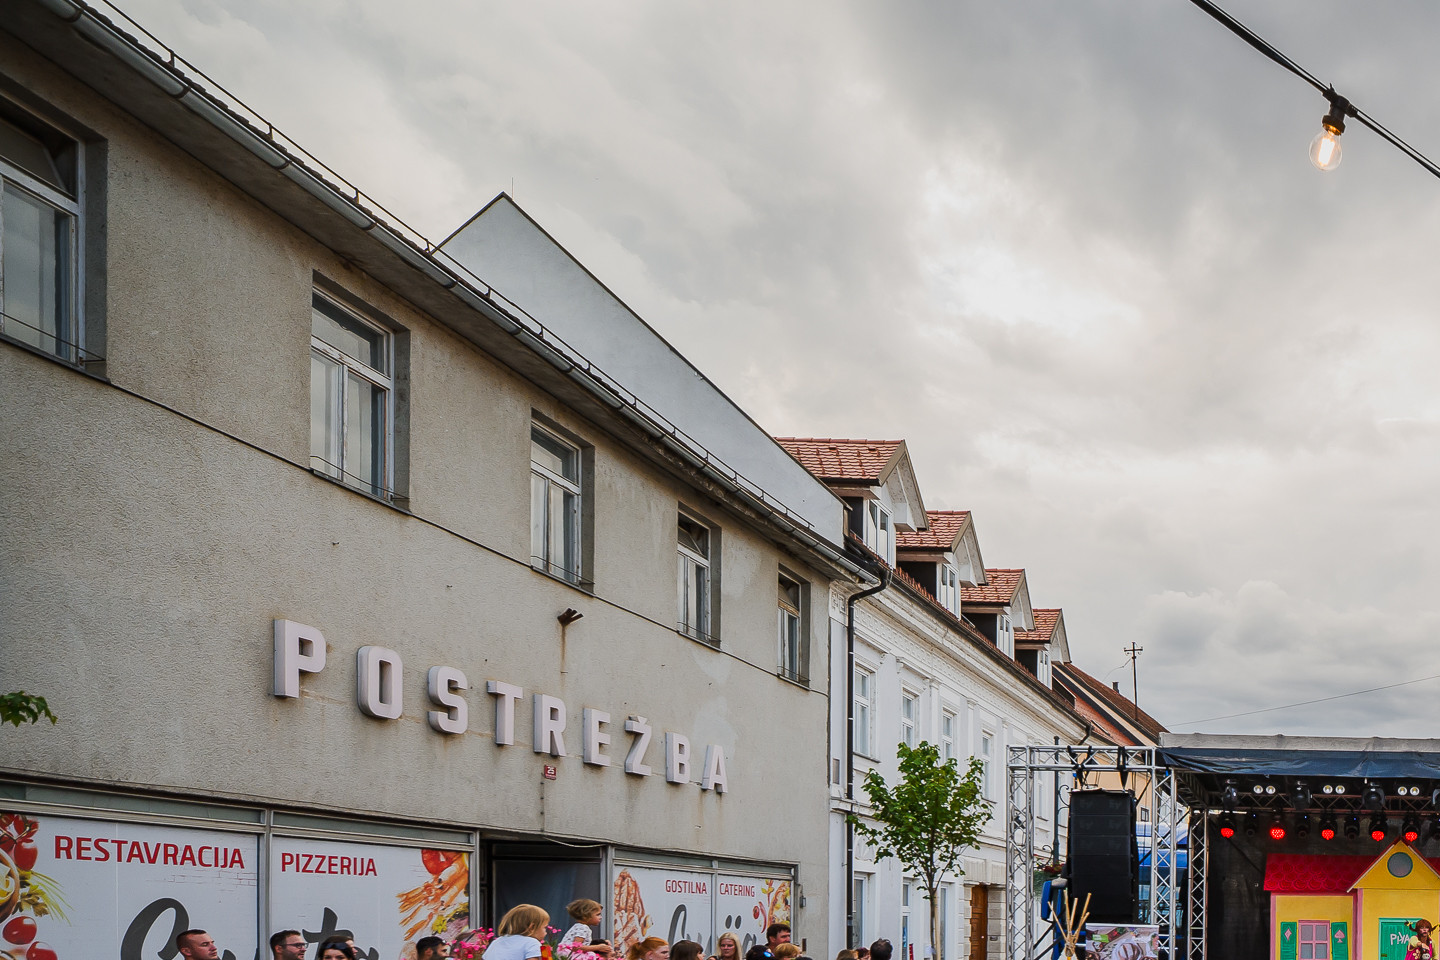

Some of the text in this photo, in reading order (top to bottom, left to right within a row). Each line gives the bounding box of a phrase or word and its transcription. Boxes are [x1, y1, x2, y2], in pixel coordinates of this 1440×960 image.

[274, 618, 729, 794] POSTREŽBA
[54, 835, 245, 869] RESTAVRACIJA
[281, 852, 378, 877] PIZZERIJA
[665, 879, 708, 895] GOSTILNA
[719, 882, 756, 898] CATERING
